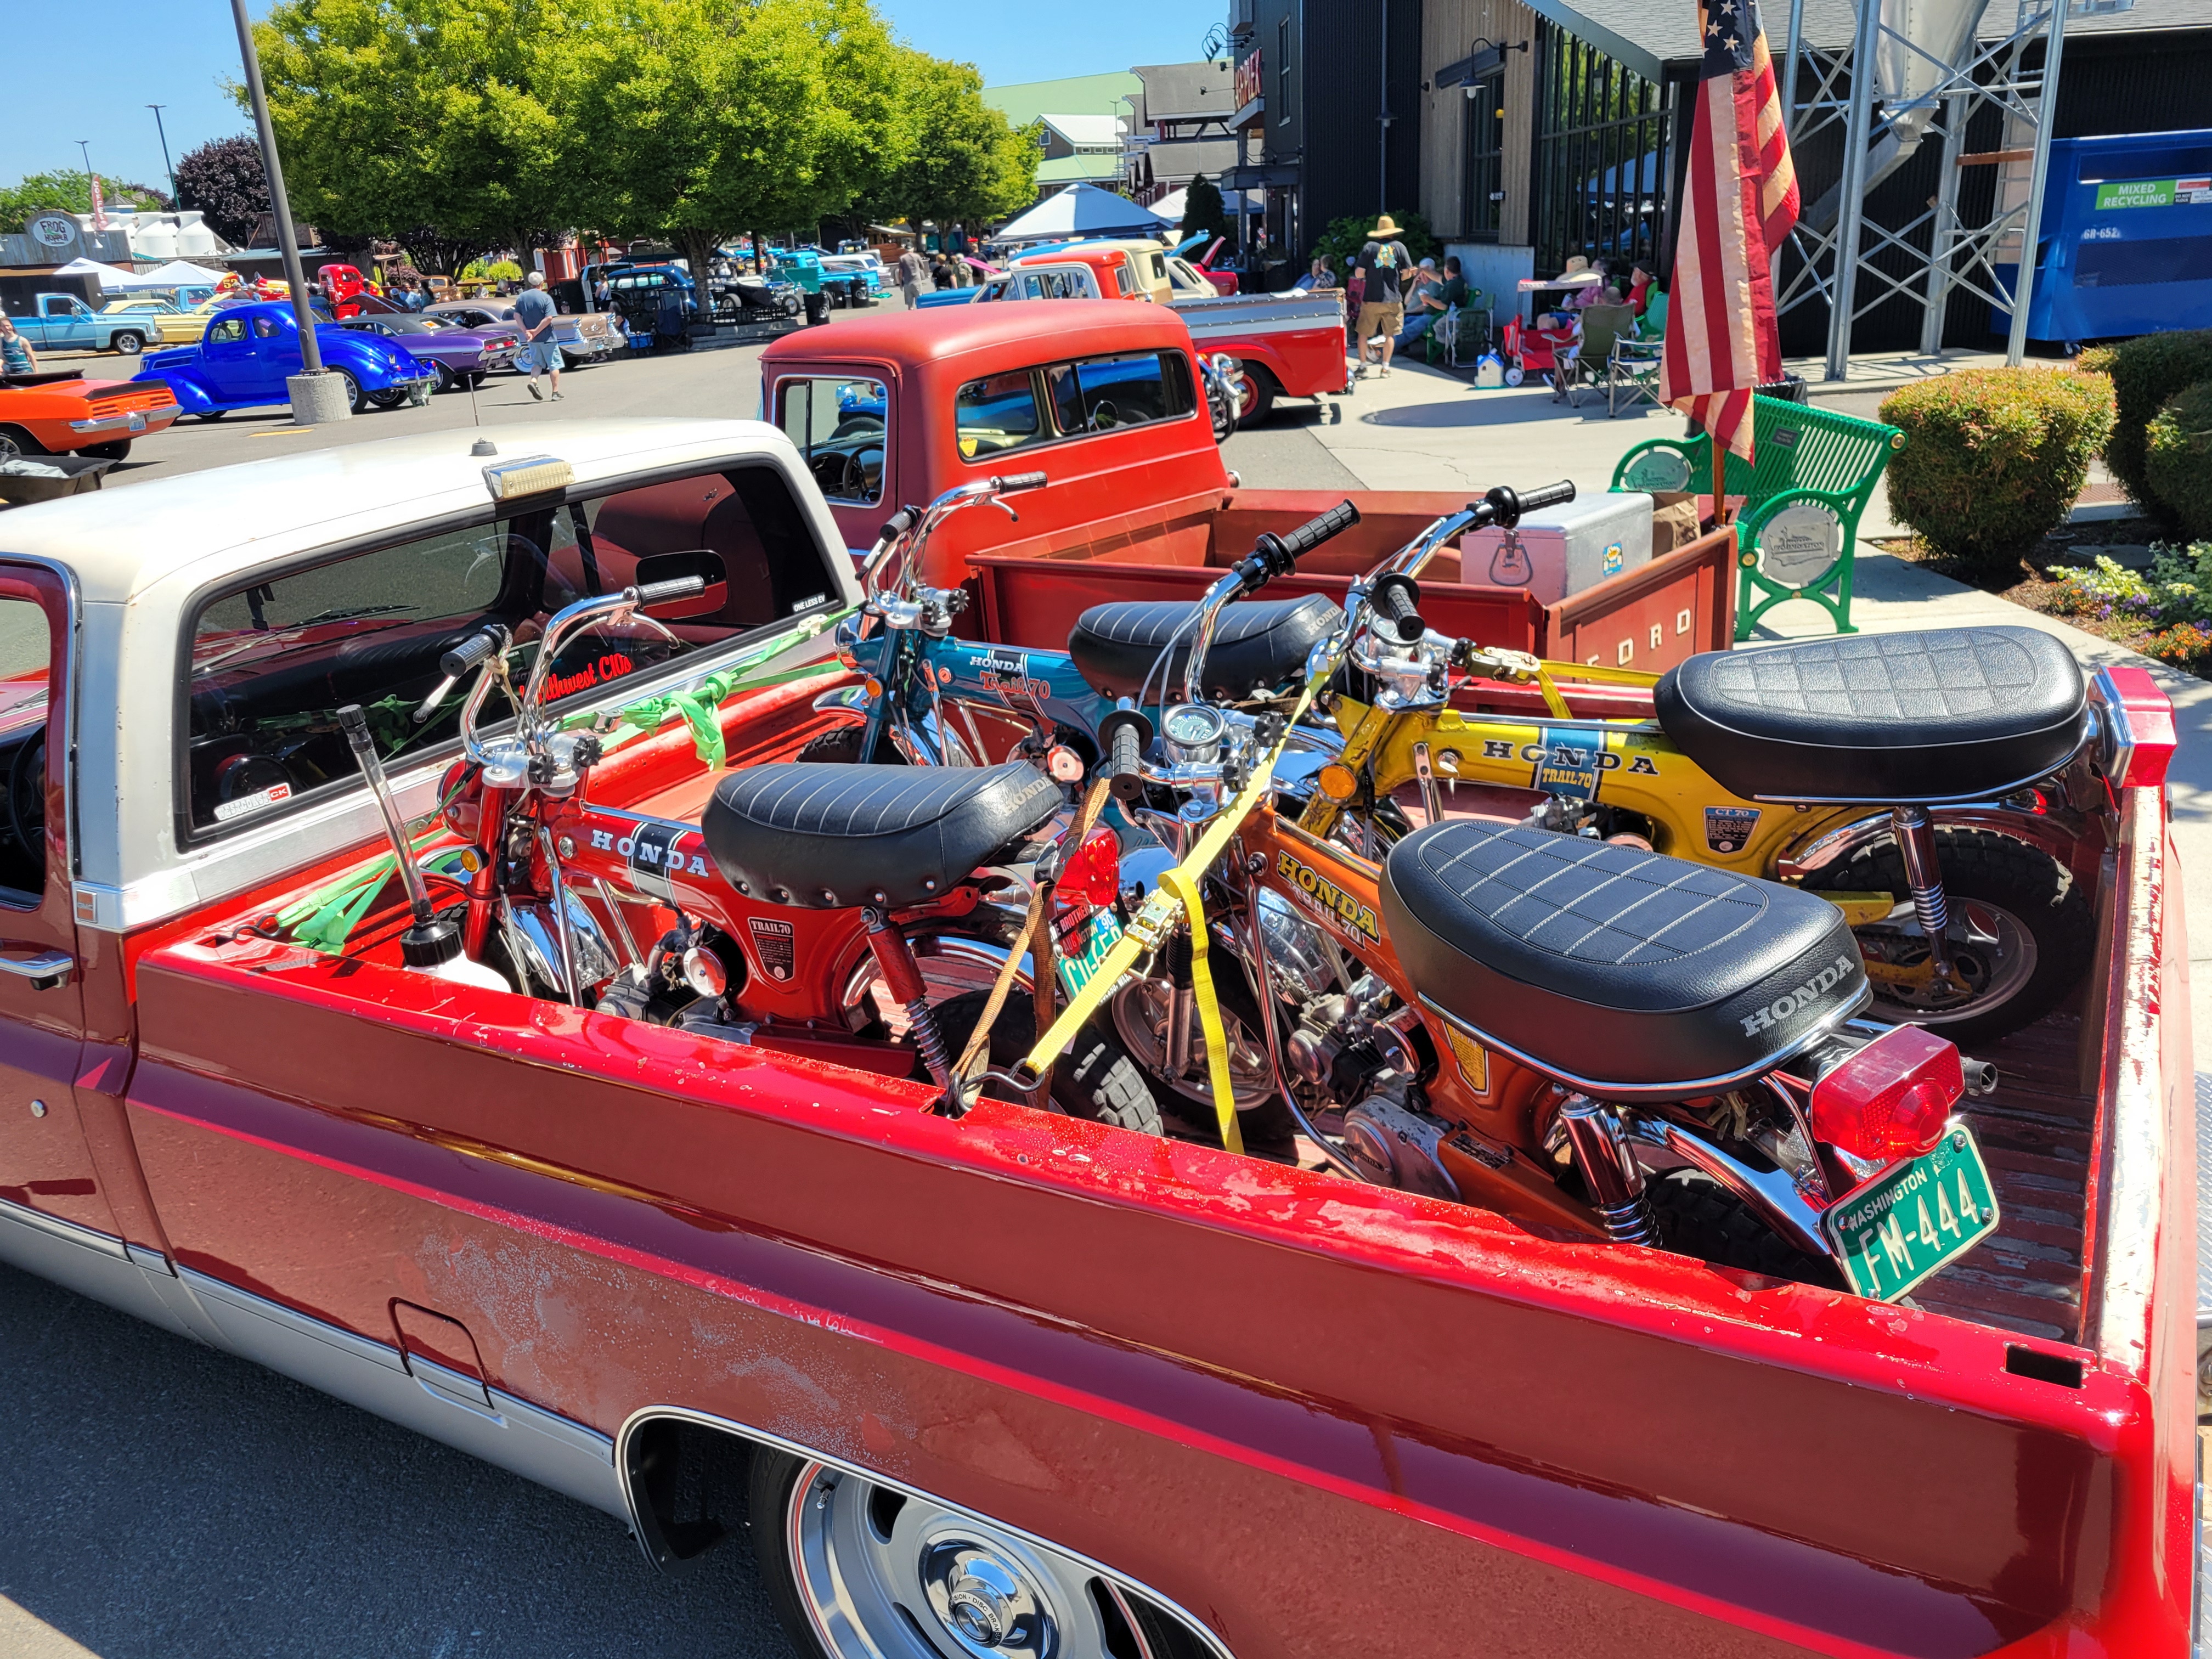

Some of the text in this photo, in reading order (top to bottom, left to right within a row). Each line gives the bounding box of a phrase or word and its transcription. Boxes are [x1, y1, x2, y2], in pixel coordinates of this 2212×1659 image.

[93, 181, 105, 219] COFFEE
[2104, 194, 2166, 207] RECYCLING
[2118, 184, 2155, 195] MIXED
[40, 221, 66, 233] FROG
[794, 594, 825, 612] ONE LESS EV
[599, 653, 631, 680] C10s
[970, 656, 1025, 673] HONDA
[1482, 740, 1660, 776] HONDA
[217, 788, 287, 819] WESTCOAST CK
[998, 776, 1053, 817] HONDA
[590, 829, 709, 878] HONDA
[1278, 850, 1379, 942] HONDA
[1059, 905, 1094, 933] BROTHERS
[1101, 913, 1114, 930] 90
[1293, 885, 1361, 944] TRAIL 70
[1062, 933, 1077, 953] AUG
[1739, 955, 1855, 1037] HONDA
[1849, 1167, 1928, 1232] WASHINGTON
[1859, 1167, 1979, 1292] FM-444
[972, 1598, 988, 1612] DISC
